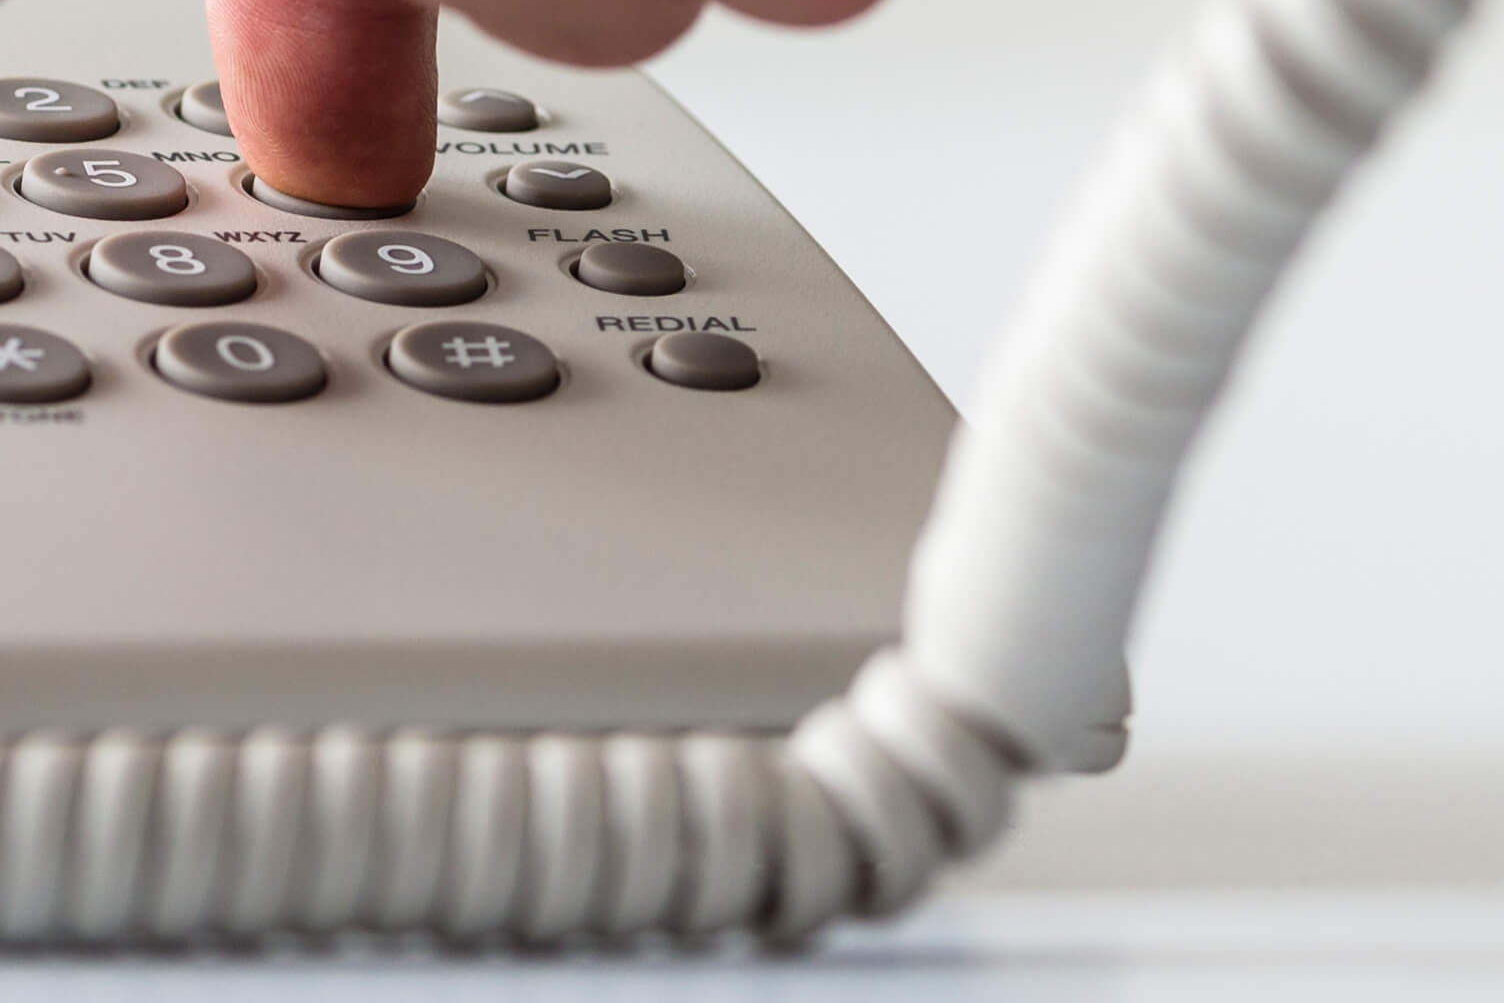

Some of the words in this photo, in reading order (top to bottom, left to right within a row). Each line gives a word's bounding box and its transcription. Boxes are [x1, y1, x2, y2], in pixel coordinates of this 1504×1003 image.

[101, 79, 170, 89] DEF
[13, 87, 73, 112] 2
[151, 151, 239, 163] MNO
[83, 160, 137, 188] 5
[2, 232, 77, 243] TUV
[214, 230, 307, 244] WXYZ
[527, 228, 670, 243] FLASH
[148, 245, 206, 275] 8
[377, 245, 434, 274] 9
[595, 316, 757, 332] REDIAL
[217, 335, 275, 371] 0
